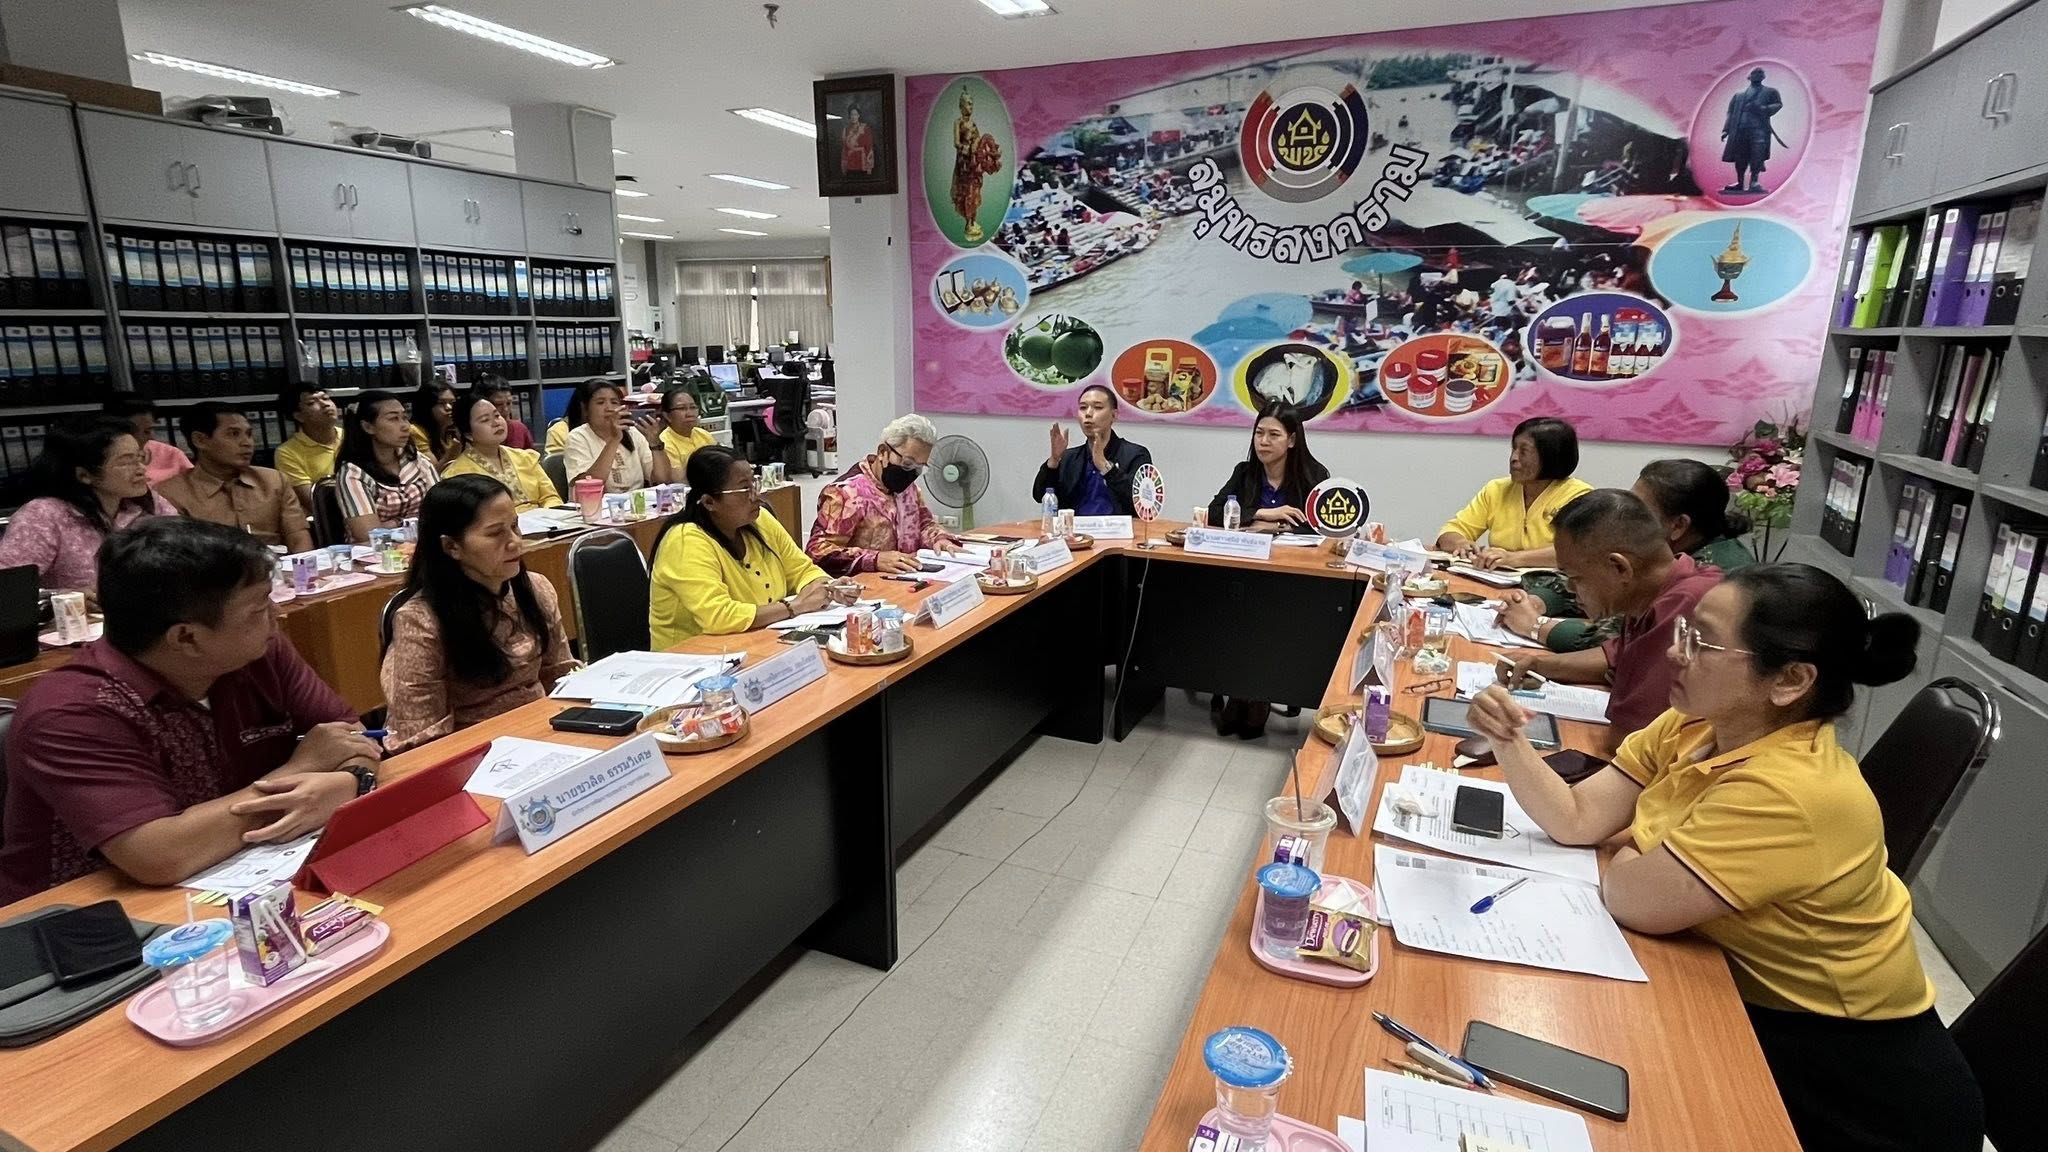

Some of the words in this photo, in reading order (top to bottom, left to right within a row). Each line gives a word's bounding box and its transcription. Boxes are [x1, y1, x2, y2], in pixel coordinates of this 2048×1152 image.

[1187, 143, 1430, 264] สมุทรสงคราม
